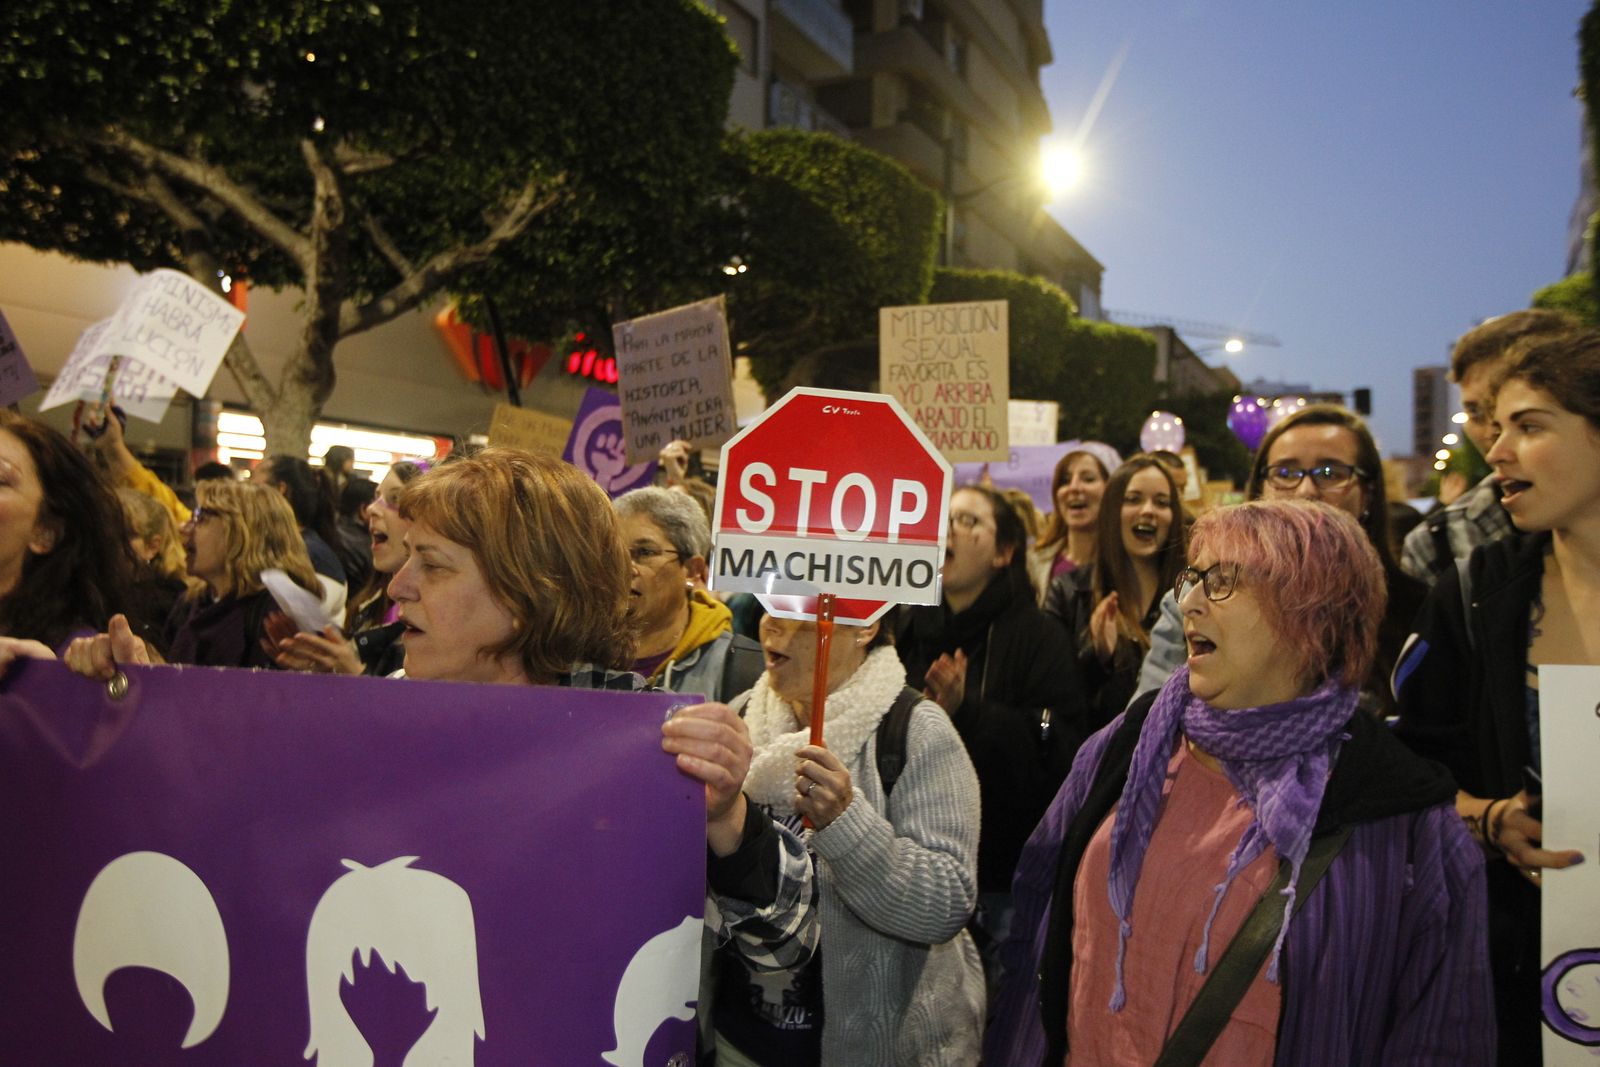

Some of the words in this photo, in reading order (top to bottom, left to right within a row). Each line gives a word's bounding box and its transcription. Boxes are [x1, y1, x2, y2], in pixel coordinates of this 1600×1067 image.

[890, 309, 917, 338] MI
[121, 323, 205, 377] LUCIÓN
[655, 333, 670, 347] LA
[901, 337, 982, 362] SEXUAL
[623, 355, 665, 376] PARTE
[671, 350, 691, 367] DE
[699, 344, 719, 363] LA
[889, 361, 959, 382] FAVORITA
[967, 360, 989, 381] ES
[625, 377, 702, 402] HISTORIA,
[898, 383, 923, 405] YO
[934, 382, 996, 405] ARRIBA
[696, 396, 723, 416] ERA
[914, 406, 969, 430] ABAJO
[973, 406, 994, 430] EL
[634, 431, 661, 449] UNA
[671, 413, 727, 441] MUJER
[736, 462, 928, 544] STOP
[719, 547, 934, 589] MACHISMO
